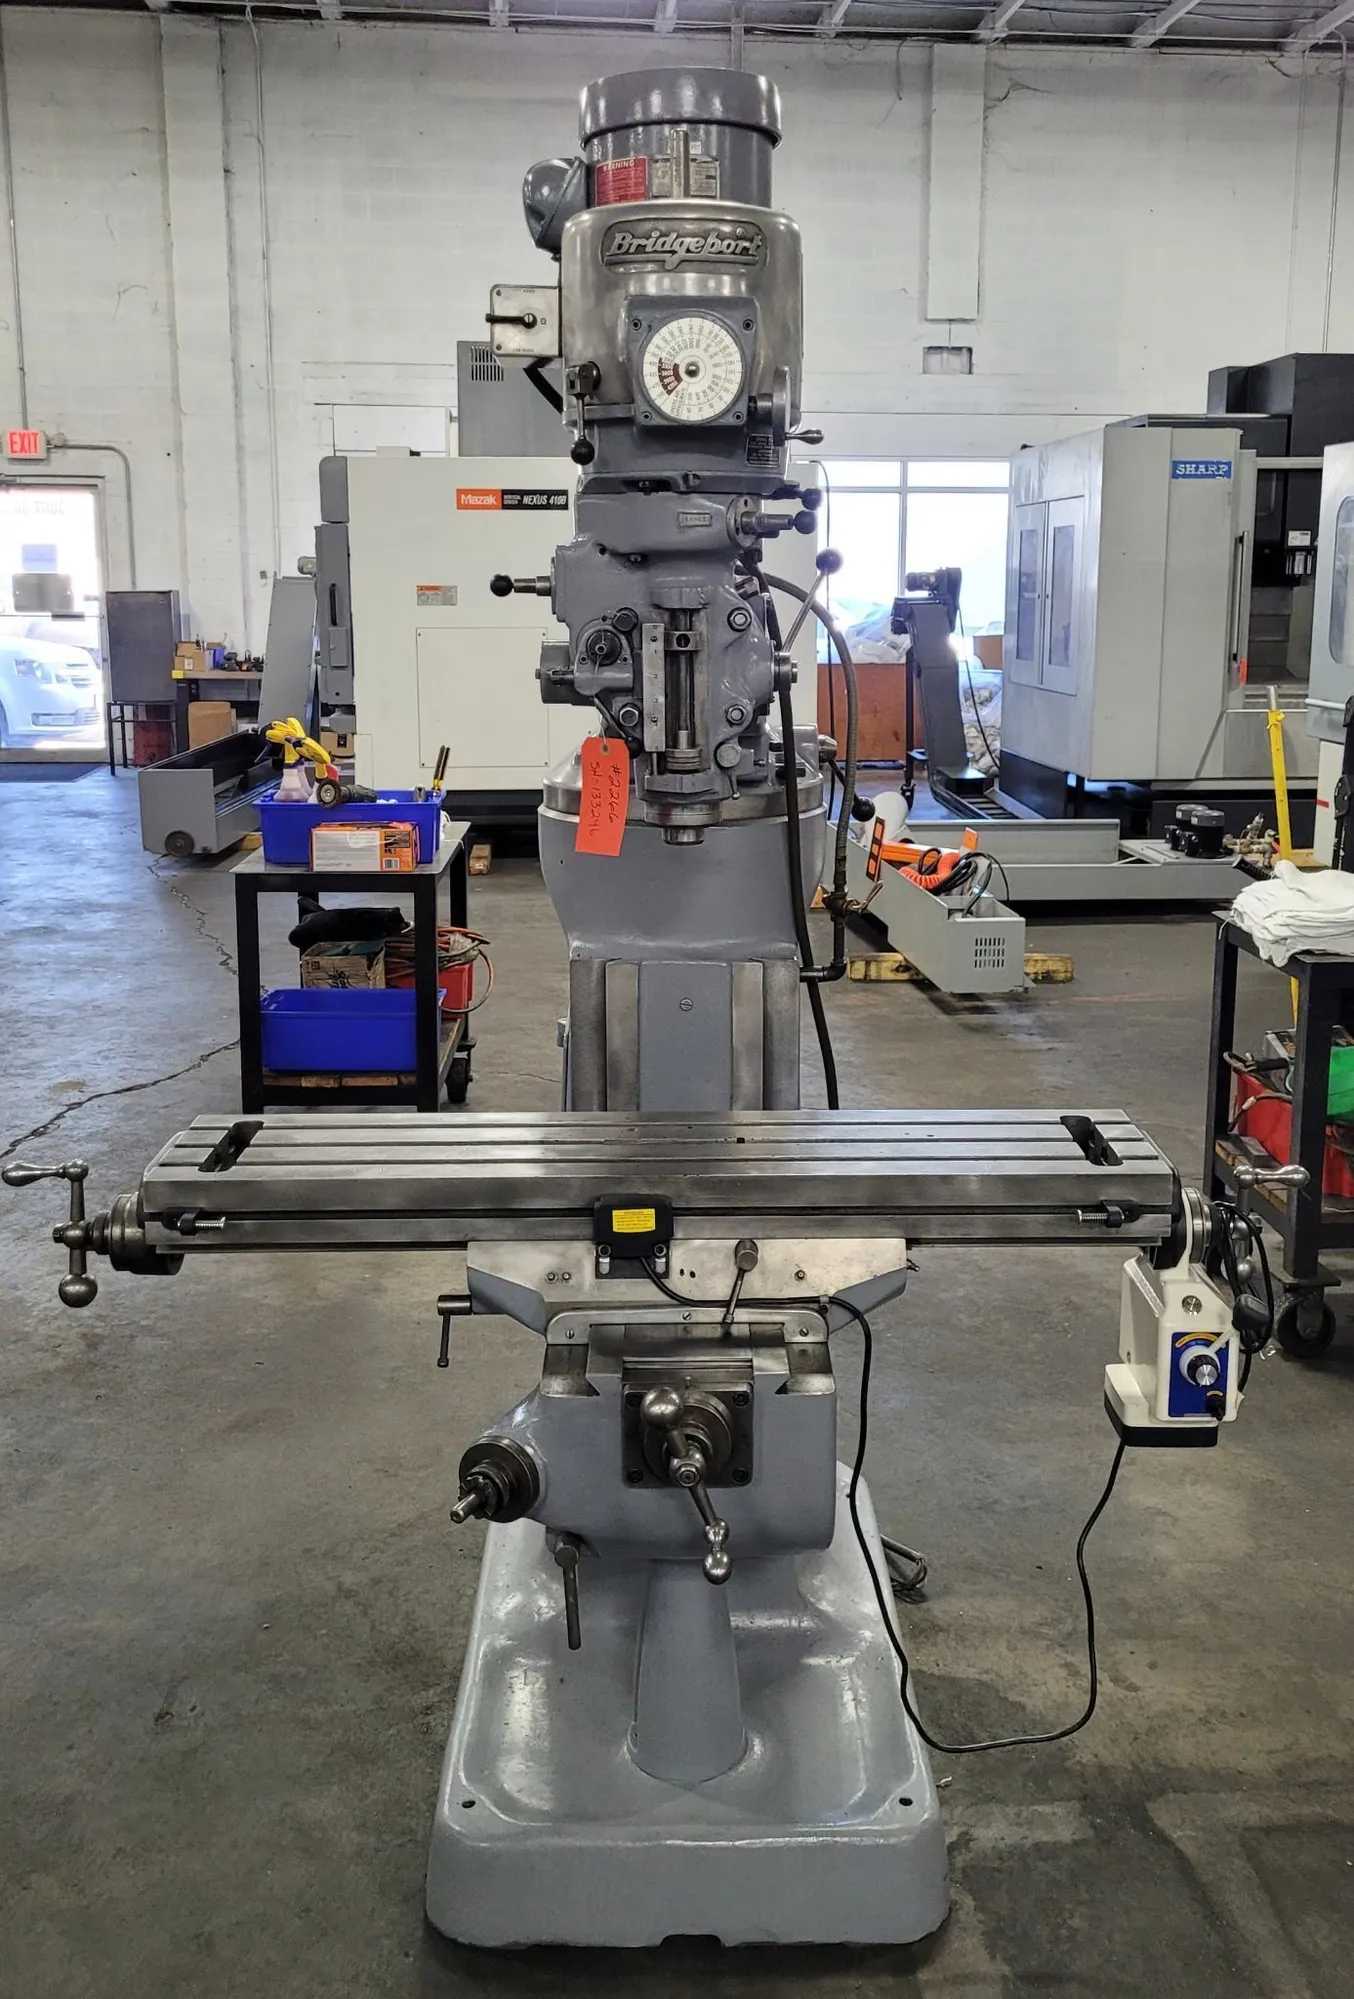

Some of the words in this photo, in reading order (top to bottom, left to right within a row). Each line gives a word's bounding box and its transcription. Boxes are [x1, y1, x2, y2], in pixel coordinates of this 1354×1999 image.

[605, 230, 763, 271] Bridgeport
[10, 432, 38, 454] EXIT
[1175, 464, 1229, 475] SHARP
[460, 494, 497, 505] Mazak
[522, 494, 547, 506] NEXUS
